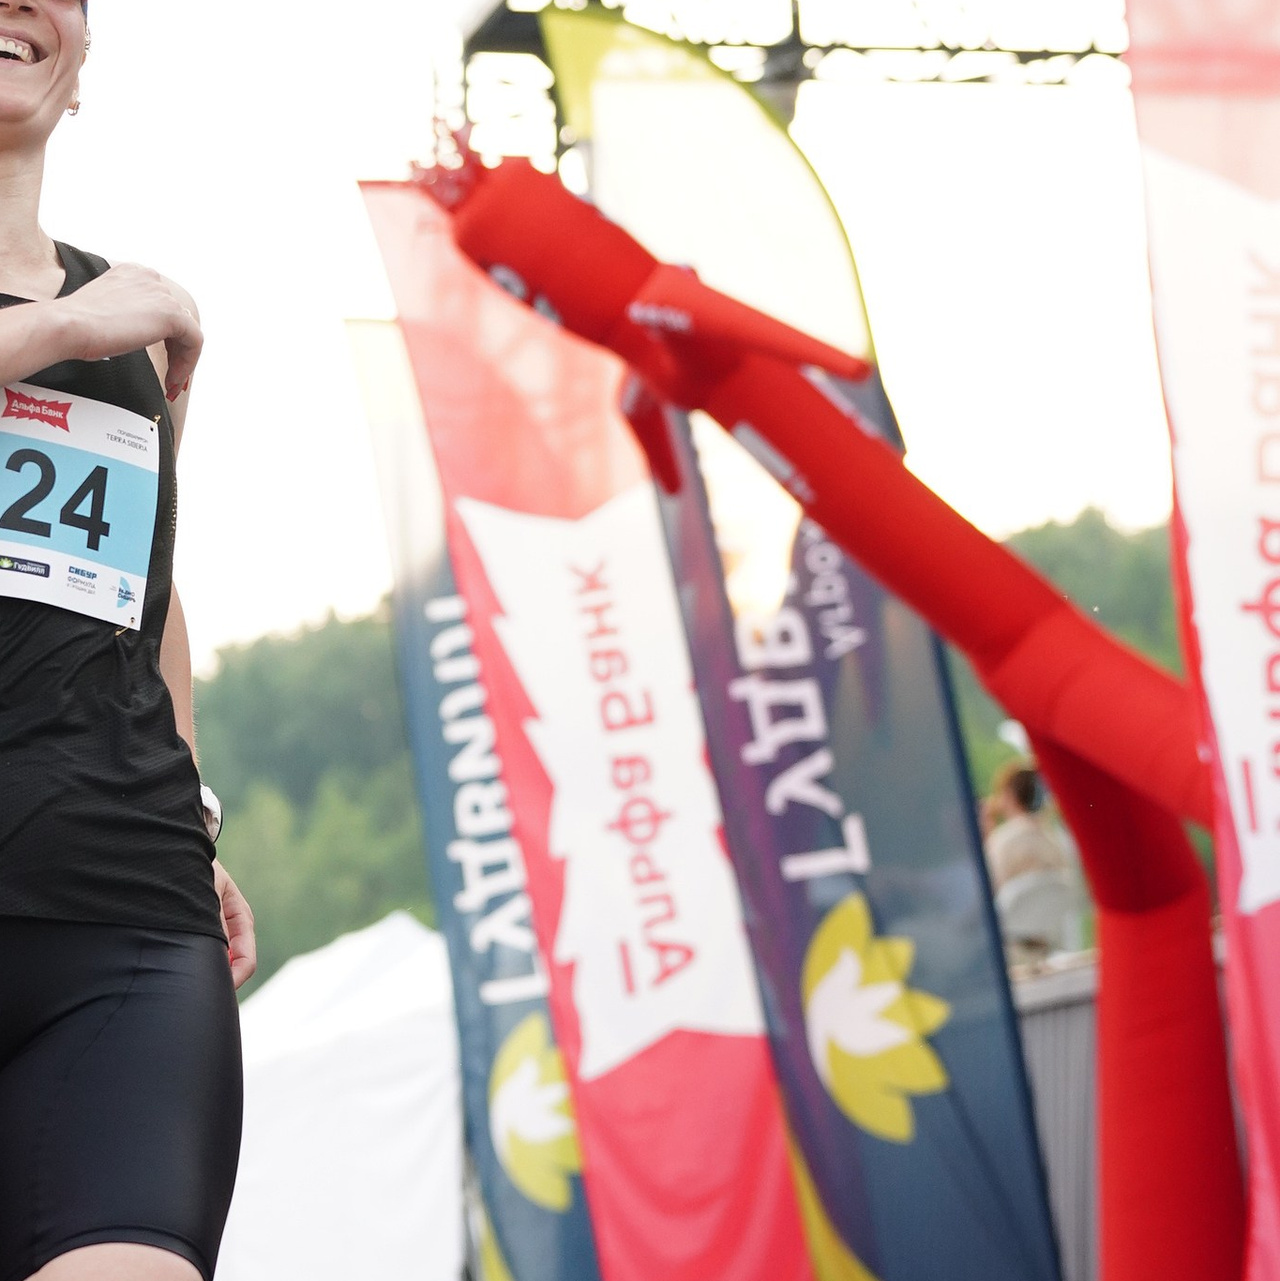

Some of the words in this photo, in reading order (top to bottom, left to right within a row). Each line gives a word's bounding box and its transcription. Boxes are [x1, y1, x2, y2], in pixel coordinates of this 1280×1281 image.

[11, 399, 40, 414] Альфа
[41, 405, 64, 419] Банк
[68, 566, 97, 580] СИБУР
